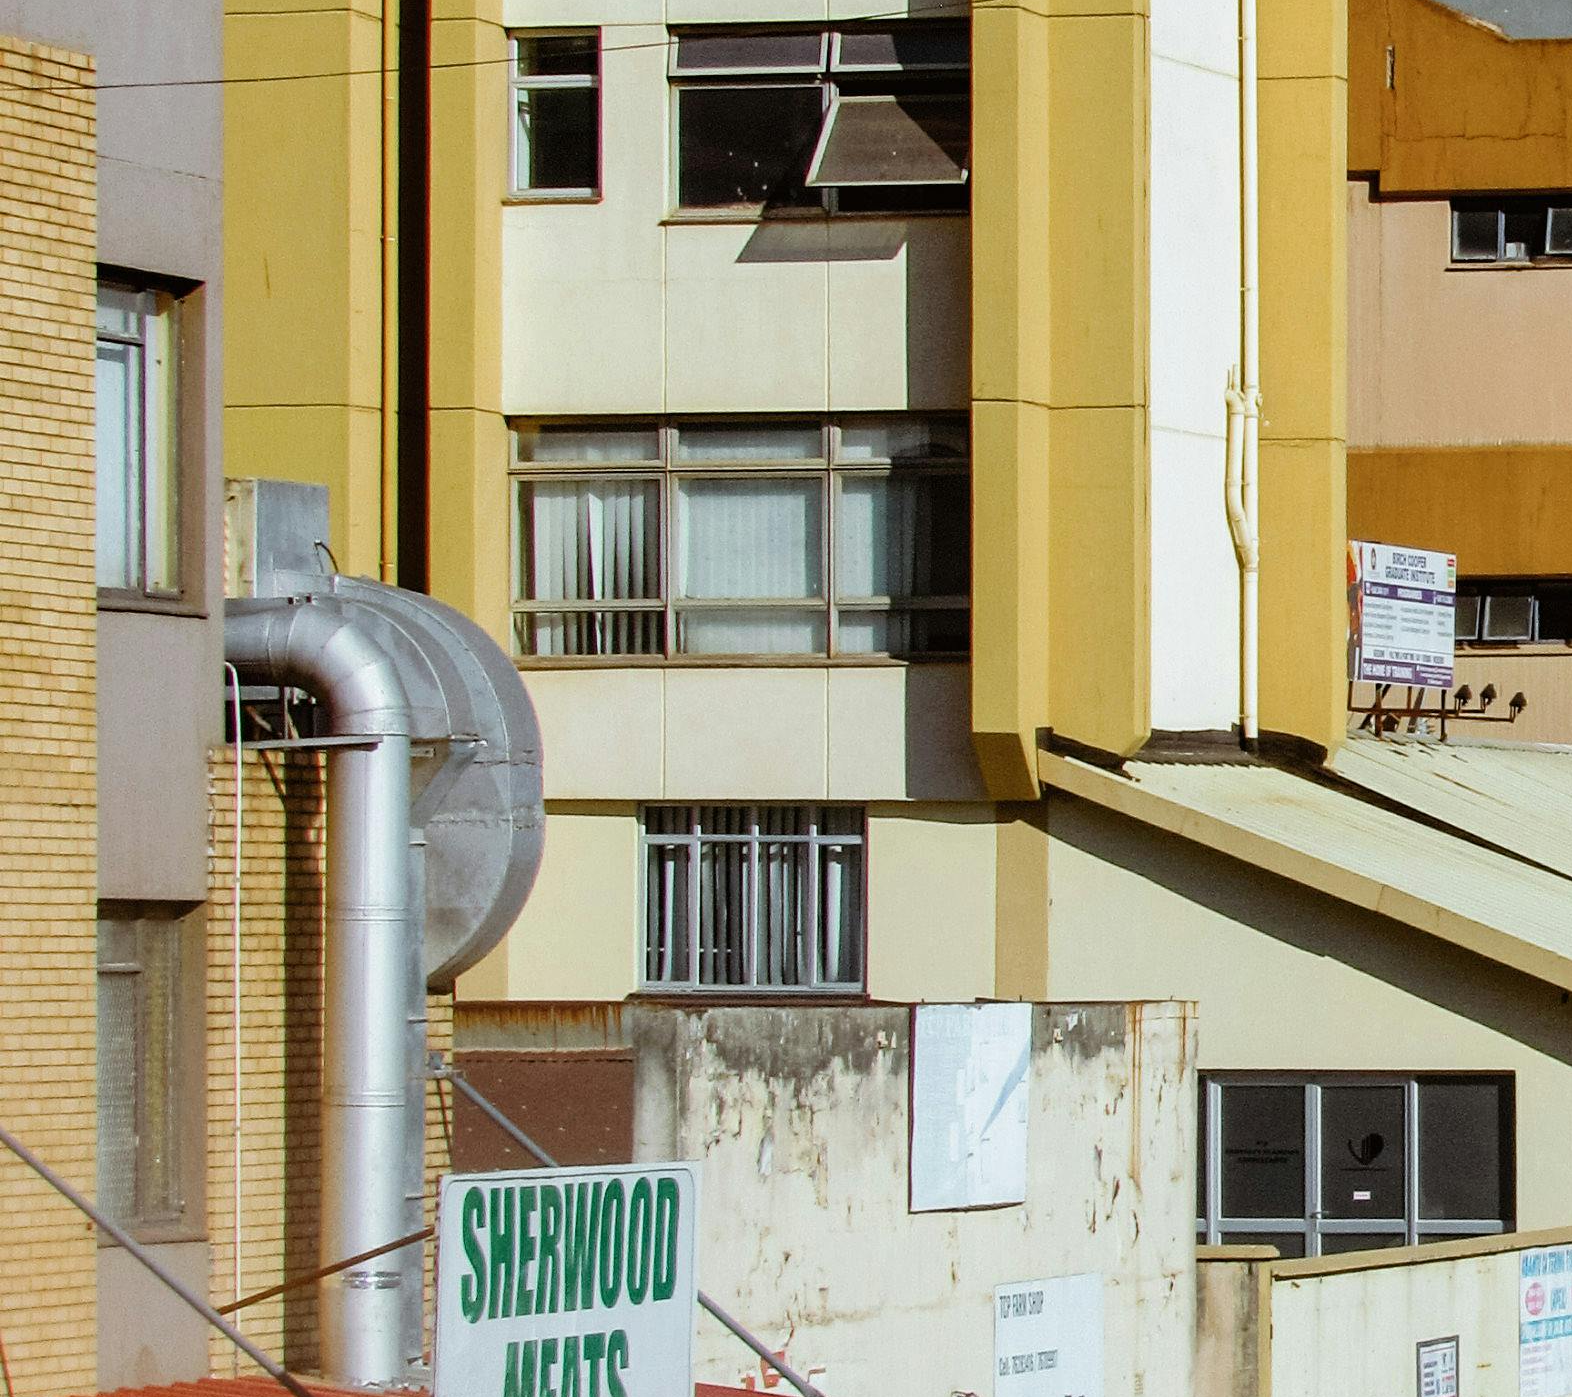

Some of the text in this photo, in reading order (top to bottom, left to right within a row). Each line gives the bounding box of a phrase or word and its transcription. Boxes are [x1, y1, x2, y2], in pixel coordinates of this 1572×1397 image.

[460, 1176, 680, 1324] SHERWOOD
[1012, 1292, 1027, 1316] FARM
[1028, 1290, 1044, 1315] SHOP
